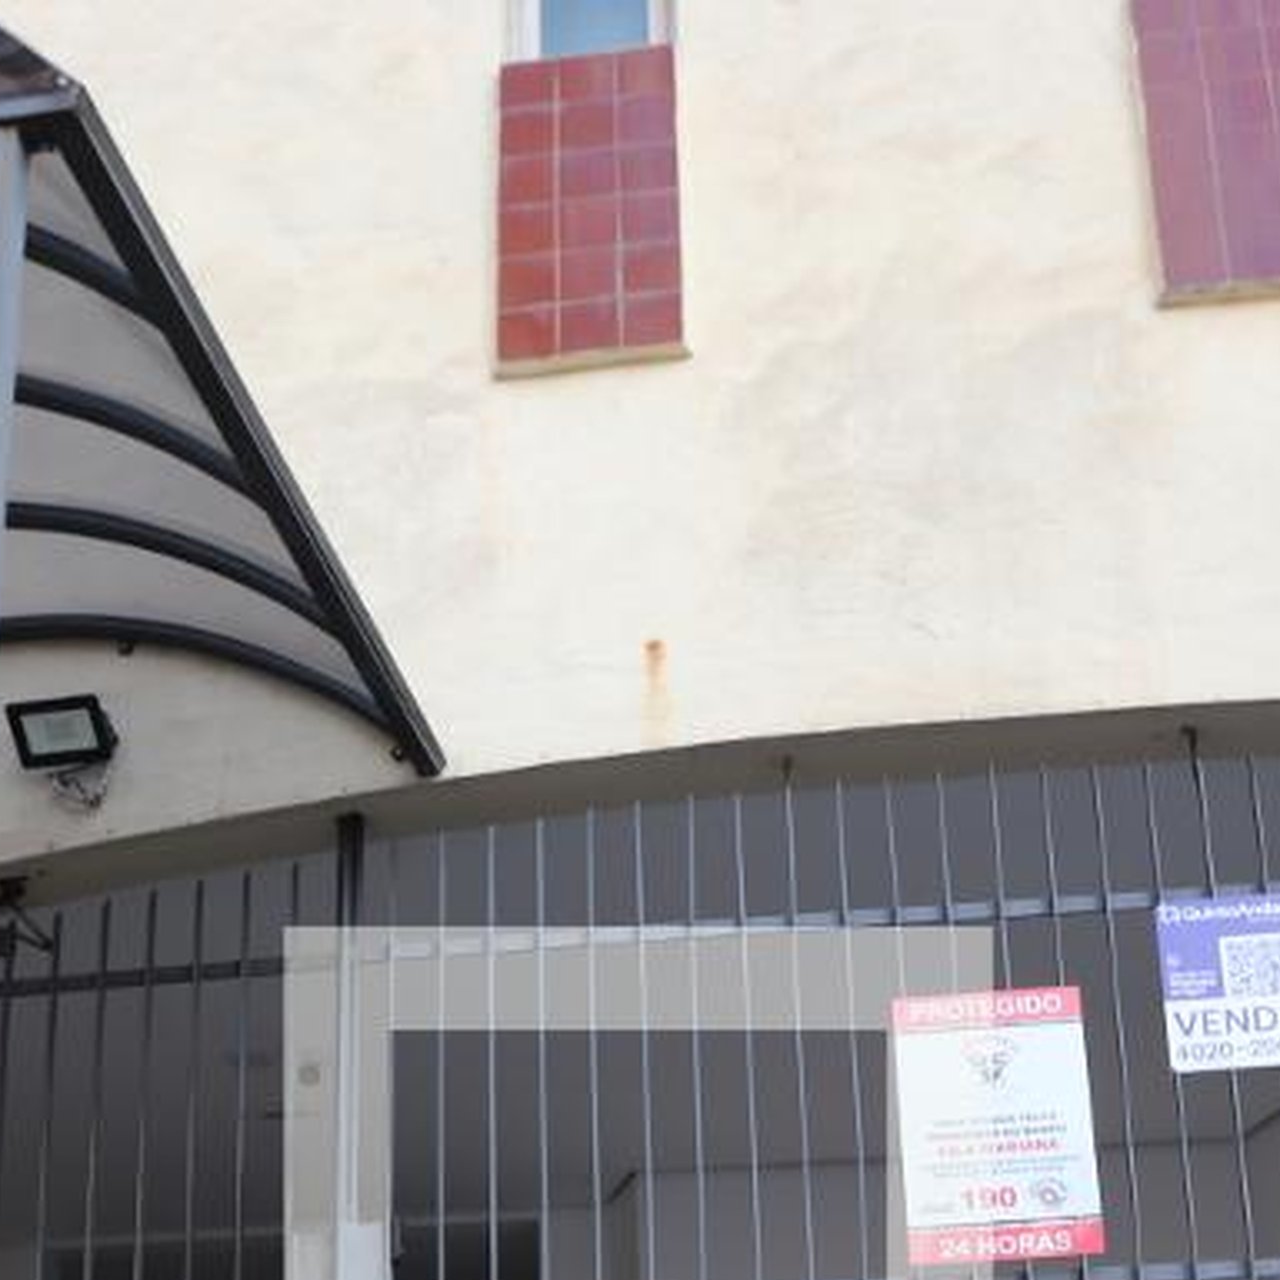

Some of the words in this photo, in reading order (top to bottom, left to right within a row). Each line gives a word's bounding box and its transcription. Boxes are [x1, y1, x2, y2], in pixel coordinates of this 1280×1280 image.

[907, 992, 1062, 1022] PROTEGIDO
[960, 1185, 1018, 1211] 190
[974, 1230, 1073, 1255] HORAS
